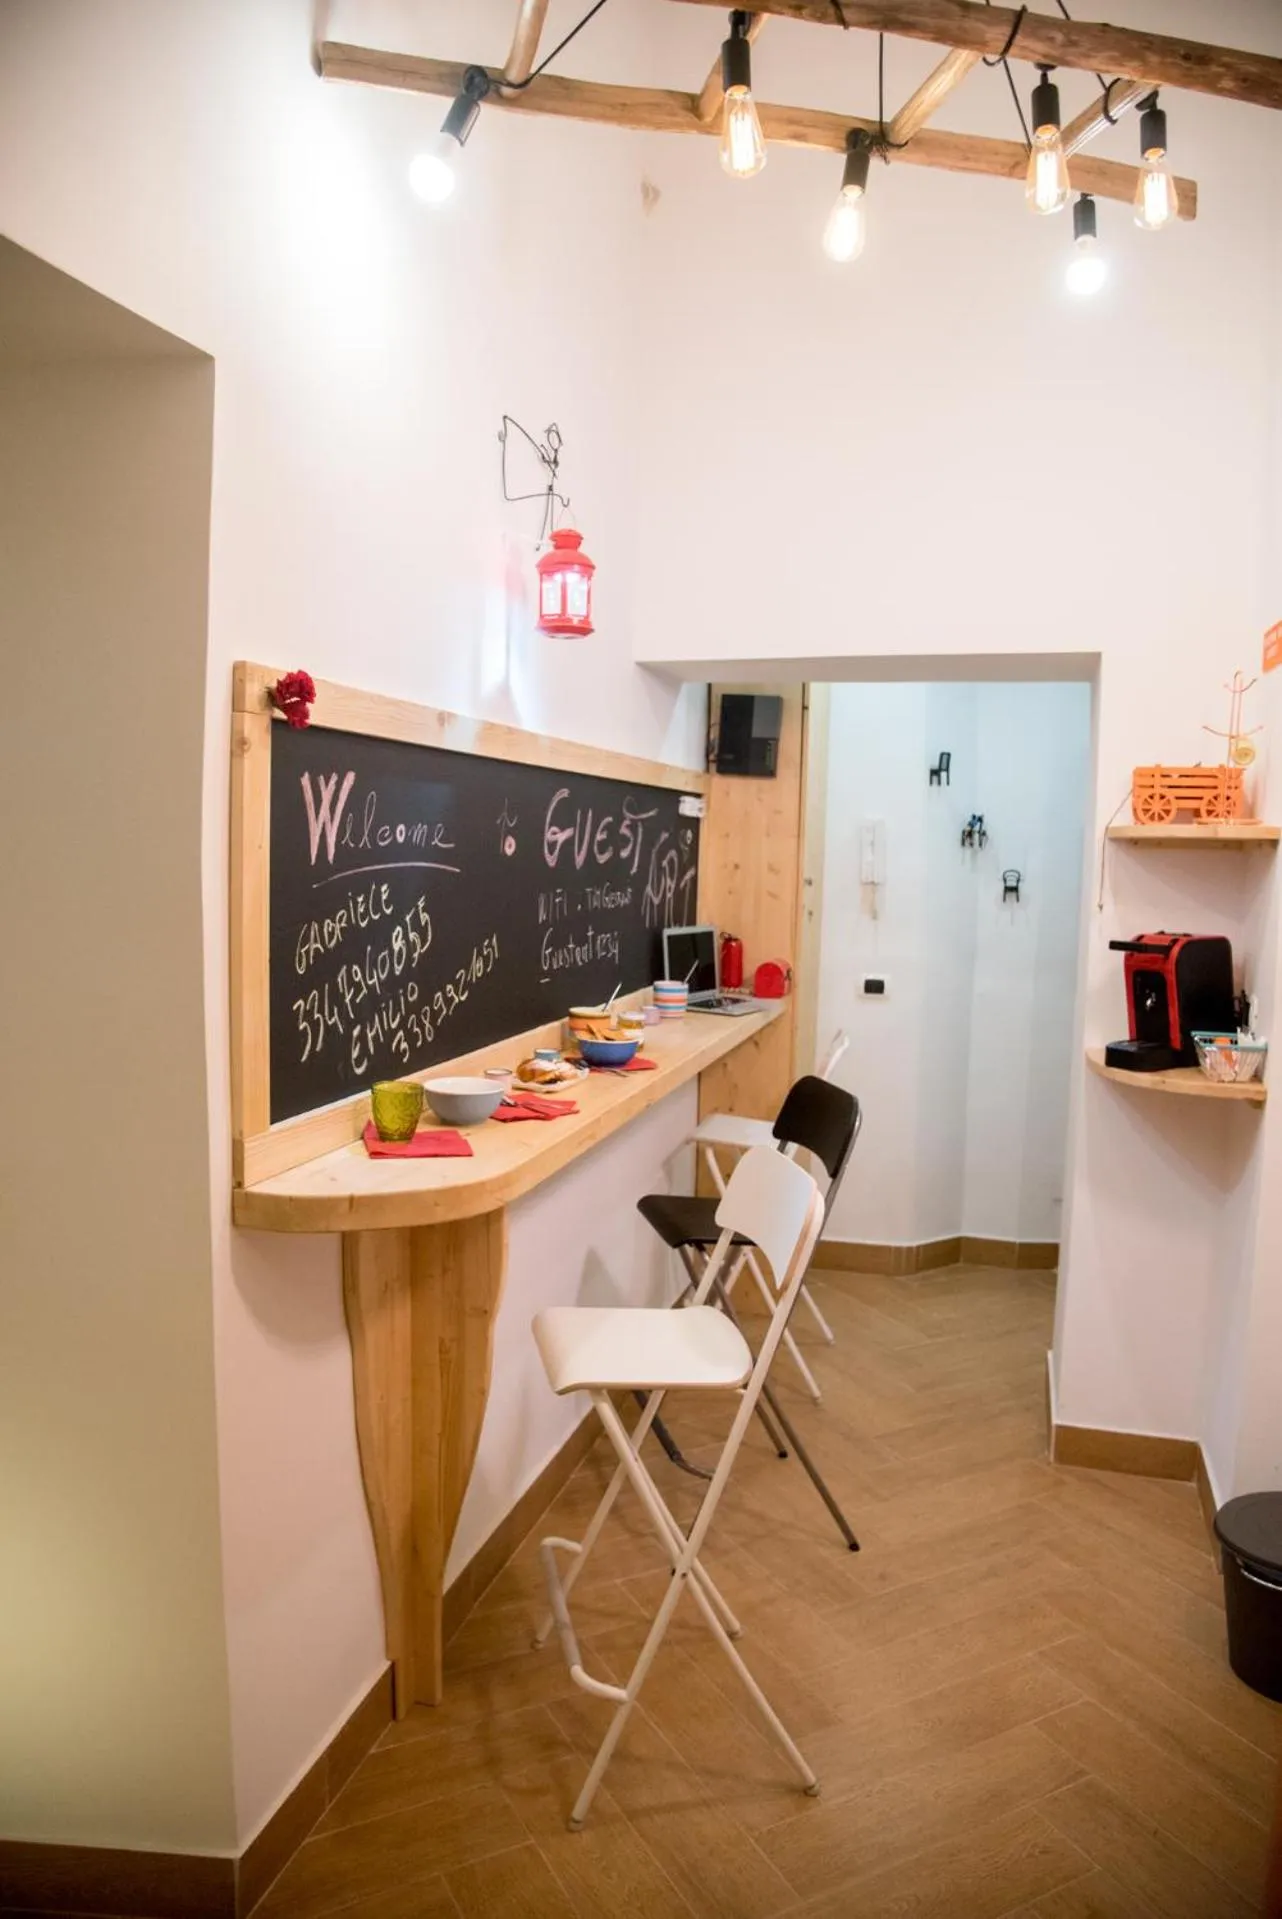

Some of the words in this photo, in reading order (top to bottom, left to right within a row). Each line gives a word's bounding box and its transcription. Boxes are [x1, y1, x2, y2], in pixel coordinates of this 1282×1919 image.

[301, 771, 456, 866] Welcome
[544, 788, 658, 874] GUEST
[351, 982, 418, 1075] EMILIO
